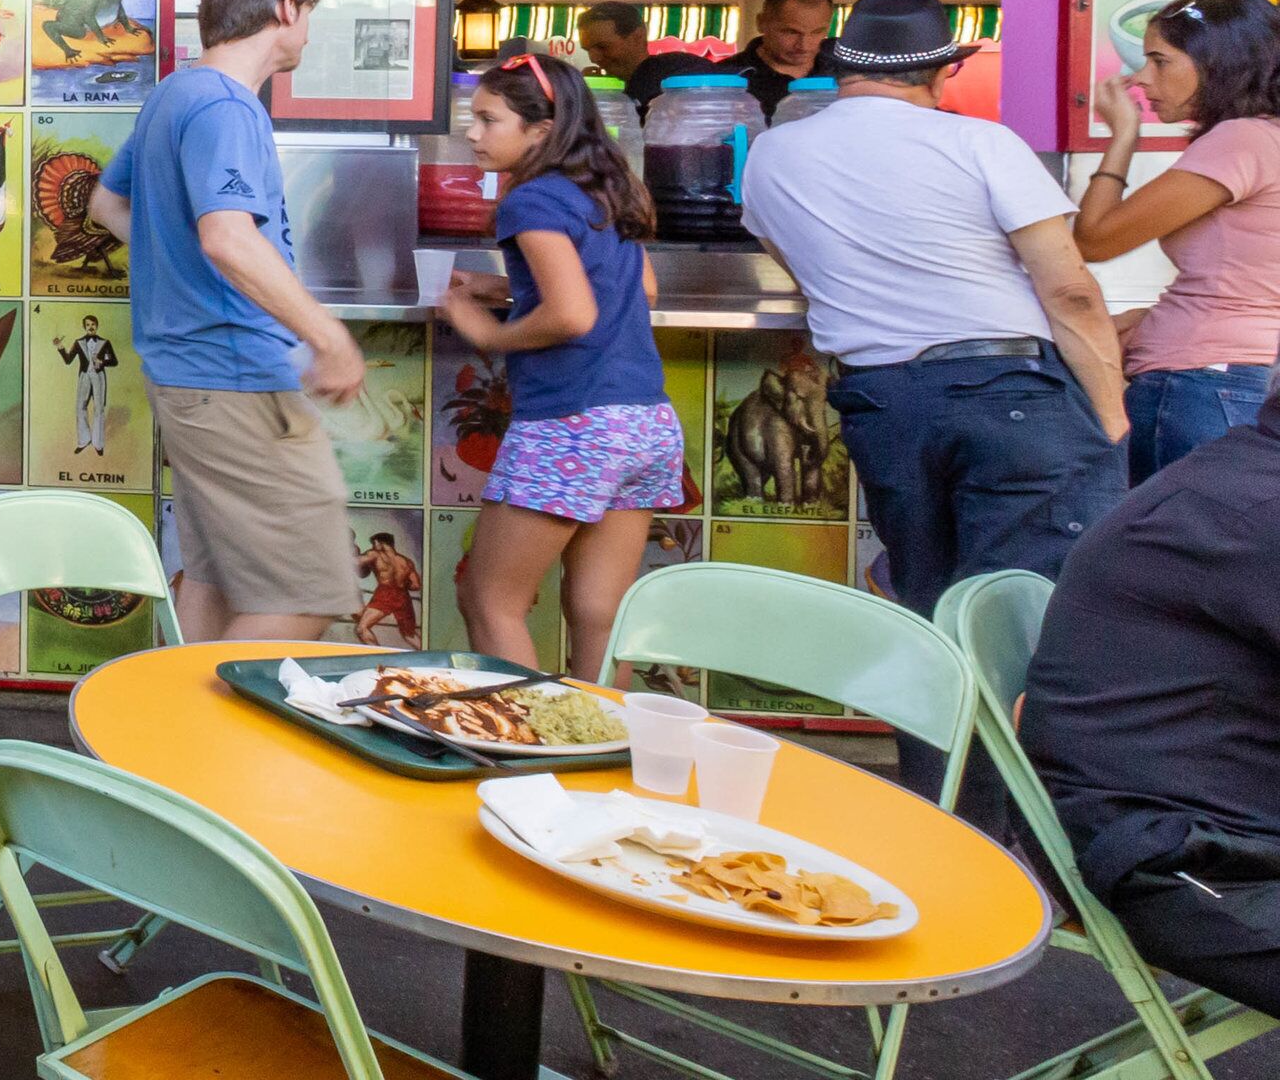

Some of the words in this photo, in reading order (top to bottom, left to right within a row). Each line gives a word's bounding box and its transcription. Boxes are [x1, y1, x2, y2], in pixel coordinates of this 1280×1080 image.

[62, 92, 78, 102] LA
[83, 91, 119, 102] RANA
[38, 116, 54, 125] 80
[47, 283, 61, 293] EL
[66, 283, 130, 295] GUAJOLOT
[33, 305, 40, 315] 4
[59, 472, 73, 483] EL
[78, 472, 125, 484] CATRIN
[354, 491, 400, 501] CISNES
[458, 494, 474, 503] LA
[743, 506, 756, 515] EL
[763, 506, 822, 516] ELEFANTE
[857, 530, 872, 540] 37
[58, 663, 72, 672] LA
[729, 699, 742, 708] EL
[749, 699, 815, 712] TELEFONO
